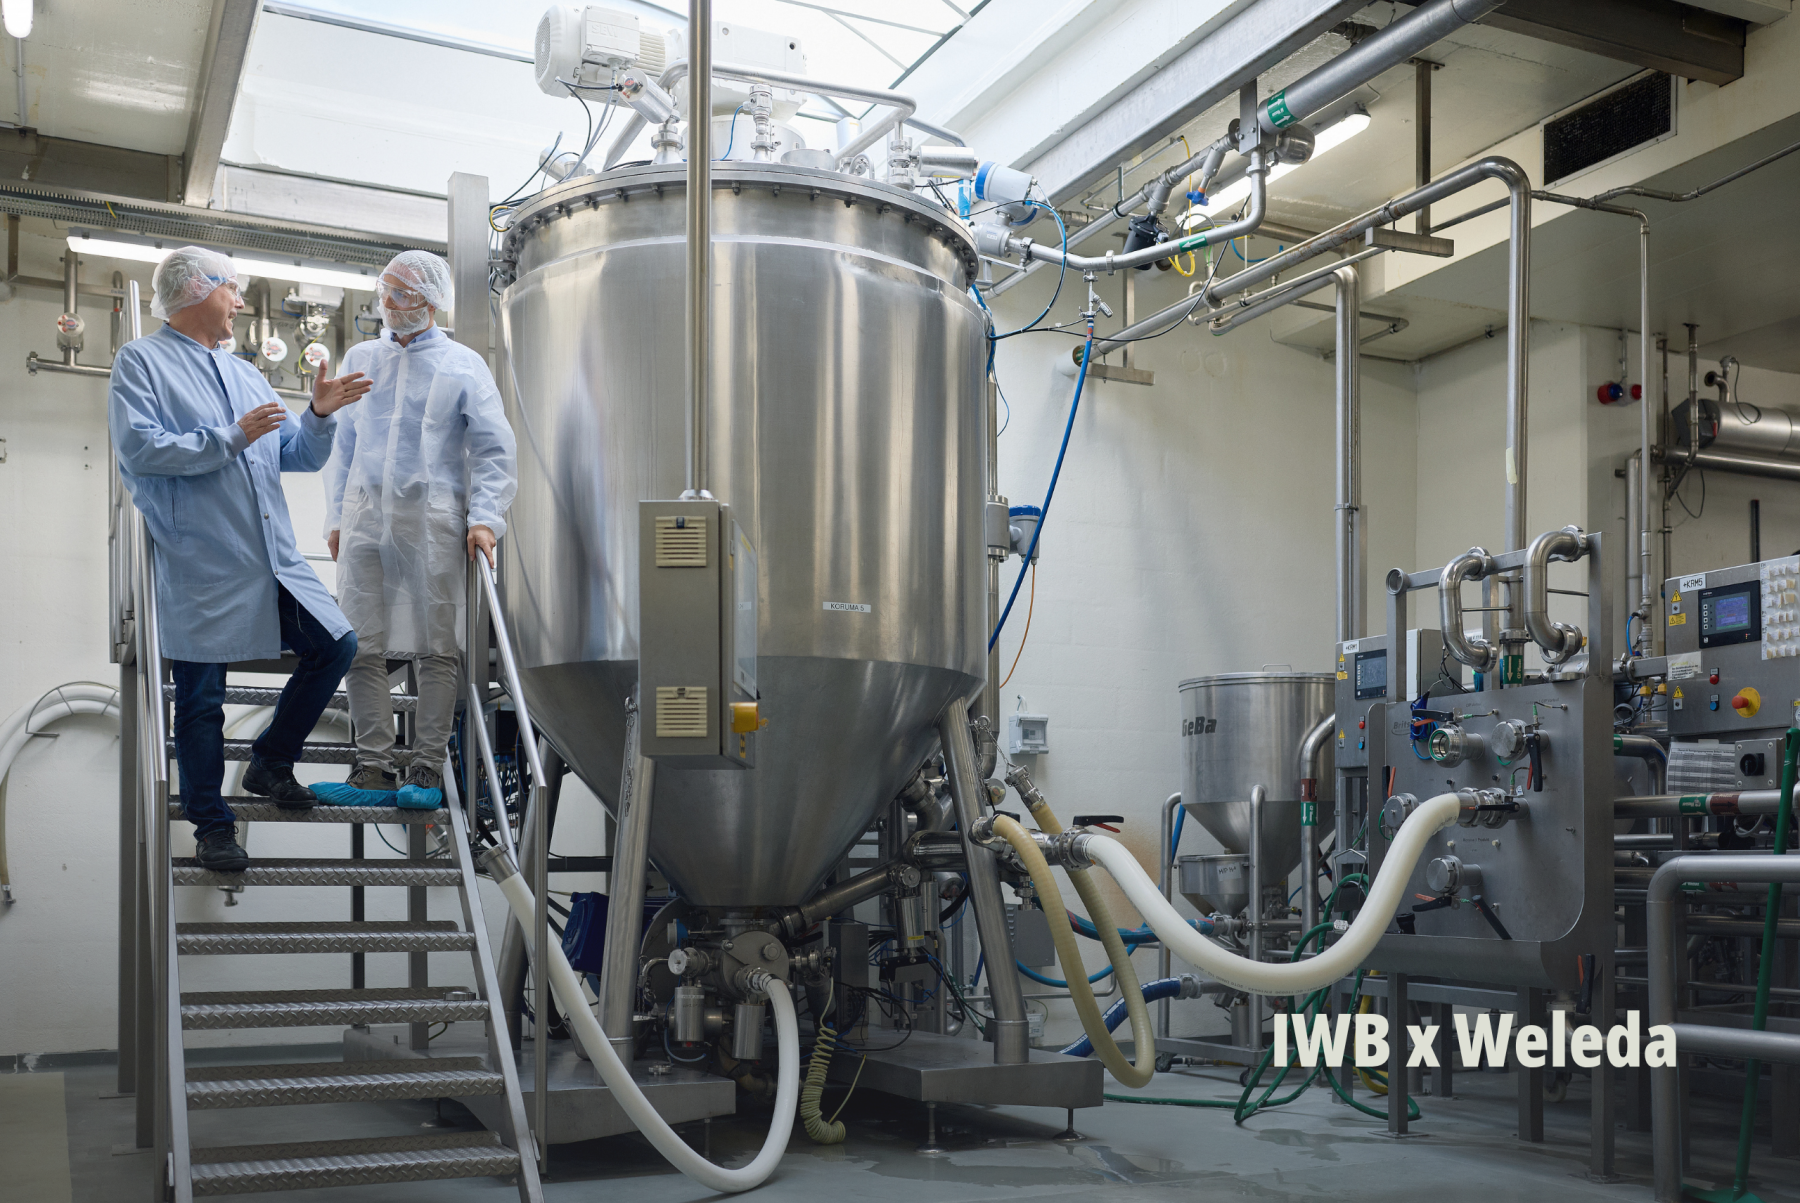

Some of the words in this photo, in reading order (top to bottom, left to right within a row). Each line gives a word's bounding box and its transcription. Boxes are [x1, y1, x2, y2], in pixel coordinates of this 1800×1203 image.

[830, 603, 859, 611] KORUMA
[860, 604, 865, 612] 5
[1182, 715, 1218, 737] GeBa
